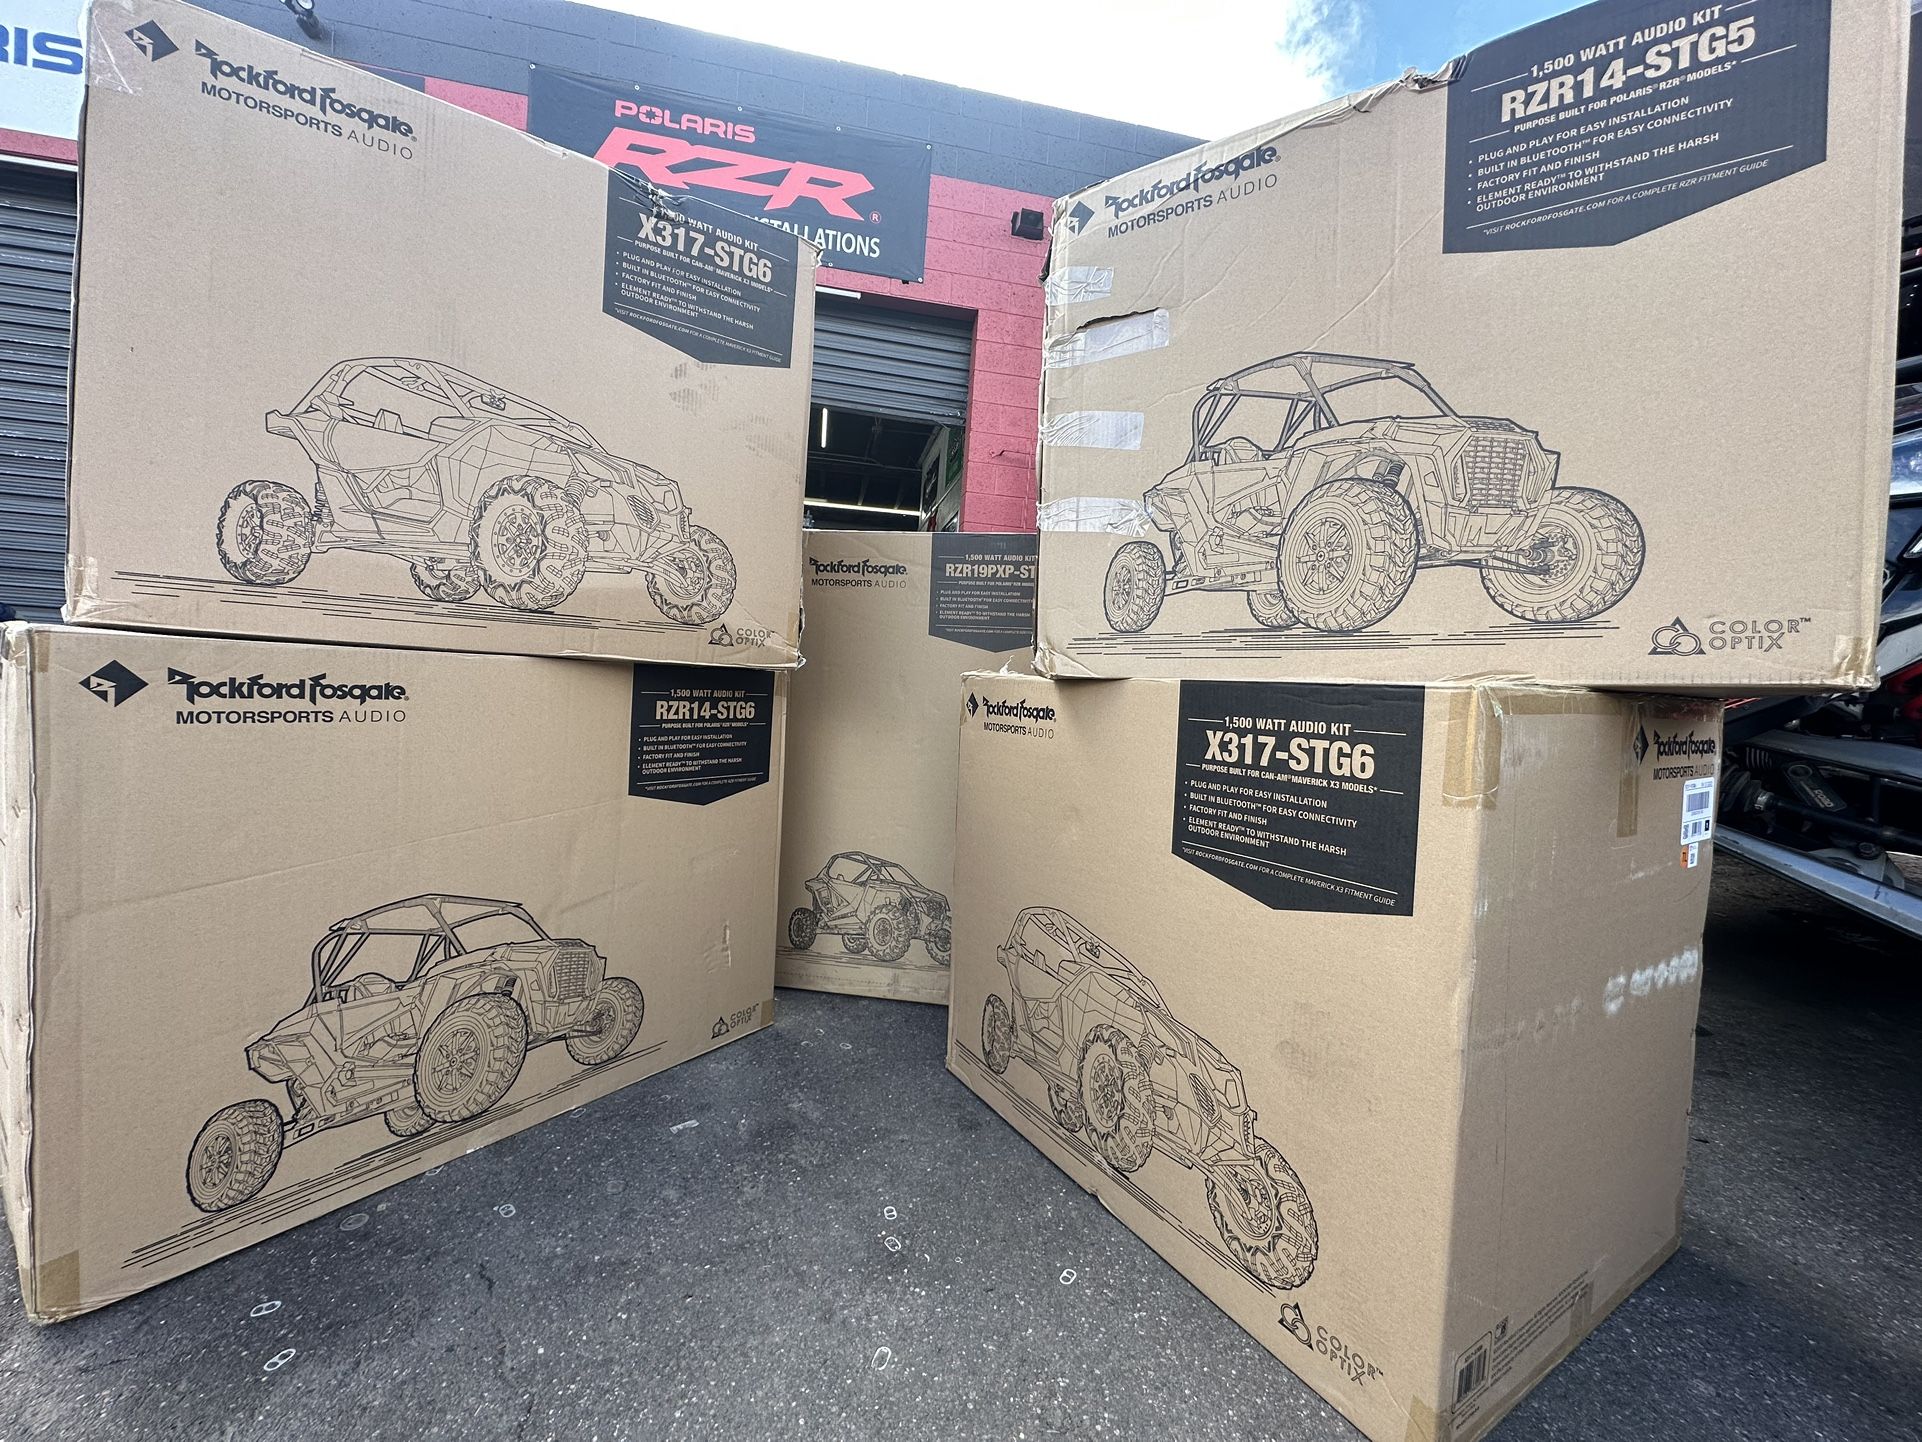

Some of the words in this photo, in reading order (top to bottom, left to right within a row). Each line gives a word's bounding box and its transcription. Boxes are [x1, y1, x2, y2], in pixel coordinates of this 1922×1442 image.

[0, 24, 83, 74] IS
[1530, 53, 1574, 78] 1,500
[1580, 36, 1626, 62] WATT
[1632, 17, 1686, 45] AUDIO
[1693, 5, 1722, 26] KIT
[195, 39, 316, 107] Rockford
[1501, 16, 1755, 122] RZR14-STG5
[201, 81, 343, 138] MOTORSPORTS
[347, 130, 414, 160] AUDIO
[614, 99, 756, 143] POLARIS
[1478, 149, 1504, 163] PLUG
[1506, 143, 1527, 156] AND
[1529, 135, 1554, 149] PLAY
[1557, 129, 1577, 141] FOR
[1580, 120, 1607, 134] EASY
[1608, 96, 1689, 127] INSTALLATION
[1514, 115, 1556, 133] PURPOSE
[1559, 106, 1585, 120] BUILT
[1589, 100, 1607, 112] FOR
[1478, 163, 1505, 177] BUILT
[1507, 158, 1518, 169] IN
[1592, 132, 1615, 145] FOR
[1617, 124, 1644, 138] EASY
[1647, 98, 1733, 130] CONNECTIVITY
[1476, 185, 1522, 204] ELEMENT
[1568, 169, 1582, 180] TO
[1585, 151, 1650, 176] WITHSTAND
[1652, 144, 1676, 157] THE
[1678, 132, 1720, 151] HARSH
[1477, 173, 1520, 190] FACTORY
[1523, 167, 1538, 178] FIT
[1540, 161, 1562, 174] AND
[1564, 150, 1600, 167] FINISH
[1104, 172, 1191, 220] Rockford
[1107, 194, 1213, 238] MOTORSPORTS
[1216, 173, 1278, 204] AUDIO
[1476, 193, 1526, 212] OUTDOOR
[1528, 173, 1605, 199] ENVIRONMENT
[1505, 201, 1607, 230] ROCKFORDFOSGATE.COM
[1607, 195, 1624, 206] FOR
[1632, 182, 1678, 200] COMPLETE
[1679, 177, 1697, 187] RZR
[1698, 167, 1738, 183] FITMENT
[1739, 159, 1769, 173] GUIDE
[637, 212, 772, 283] X317-STG6
[688, 217, 713, 234] WATT
[716, 228, 743, 245] AUDIO
[745, 239, 759, 251] KIT
[622, 251, 640, 262] PLUG
[641, 257, 655, 267] AND
[656, 262, 671, 272] PLAY
[672, 267, 685, 276] FOR
[686, 272, 701, 282] EASY
[701, 277, 742, 297] INSTALLATION
[622, 272, 651, 286] FACTORY
[651, 281, 662, 290] FIT
[662, 285, 676, 294] AND
[676, 289, 697, 301] FINISH
[808, 556, 860, 576] Rockford
[965, 553, 983, 562] 1,500
[1003, 554, 1023, 562] AUDIO
[811, 578, 873, 588] MOTORSPORTS
[874, 580, 907, 589] AUDIO
[735, 636, 766, 648] OPTIX
[1708, 632, 1786, 652] OPTIX
[168, 666, 306, 706] Rockford
[670, 689, 691, 698] 1,500
[692, 689, 711, 698] WATT
[712, 690, 733, 698] AUDIO
[734, 690, 746, 698] KIT
[175, 710, 334, 725] MOTORSPORTS
[338, 709, 407, 724] AUDIO
[655, 700, 756, 720] RZR14-STG6
[982, 695, 1019, 719] Rockford
[1224, 716, 1253, 730] 1,500
[1256, 718, 1287, 732] WATT
[1289, 721, 1327, 735] AUDIO
[1330, 723, 1351, 736] KIT
[983, 721, 1027, 736] MOTORSPORTS
[1027, 726, 1055, 740] AUDIO
[1204, 729, 1376, 779] X317-STG6
[1653, 765, 1694, 780] MOTORSPORTS
[1190, 779, 1207, 789] PLUG
[1207, 782, 1221, 791] AND
[1222, 784, 1238, 794] PLAY
[1239, 787, 1254, 796] FOR
[1254, 789, 1273, 799] EASY
[1273, 791, 1328, 809] INSTALLATION
[1201, 763, 1228, 774] PURPOSE
[1229, 766, 1246, 776] BUILT
[1247, 769, 1260, 778] FOR
[1292, 775, 1328, 788] MAVERICK
[1329, 780, 1340, 789] X3
[1189, 791, 1207, 801] BUILT
[1208, 795, 1215, 803] IN
[1262, 804, 1277, 814] FOR
[1278, 807, 1297, 818] EASY
[1297, 811, 1358, 829] CONNECTIVITY
[1189, 804, 1216, 816] FACTORY
[1217, 809, 1228, 818] FIT
[1228, 811, 1243, 821] AND
[1243, 814, 1268, 826] FINISH
[1188, 816, 1217, 828] ELEMENT
[1246, 827, 1256, 836] TO
[1256, 829, 1300, 846] WITHSTAND
[1301, 839, 1317, 850] THE
[1318, 842, 1347, 856] HARSH
[1188, 824, 1220, 837] OUTDOOR
[1220, 831, 1270, 849] ENVIRONMENT
[1195, 849, 1258, 871] ROCKFORDFOSGATE.COM
[1258, 864, 1270, 874] FOR
[1274, 870, 1304, 883] COMPLETE
[1304, 877, 1336, 892] MAVERICK
[1335, 884, 1344, 893] X3
[1344, 887, 1373, 900] FITMENT
[1373, 894, 1397, 907] GUIDE
[1315, 1339, 1366, 1386] OPTIX
